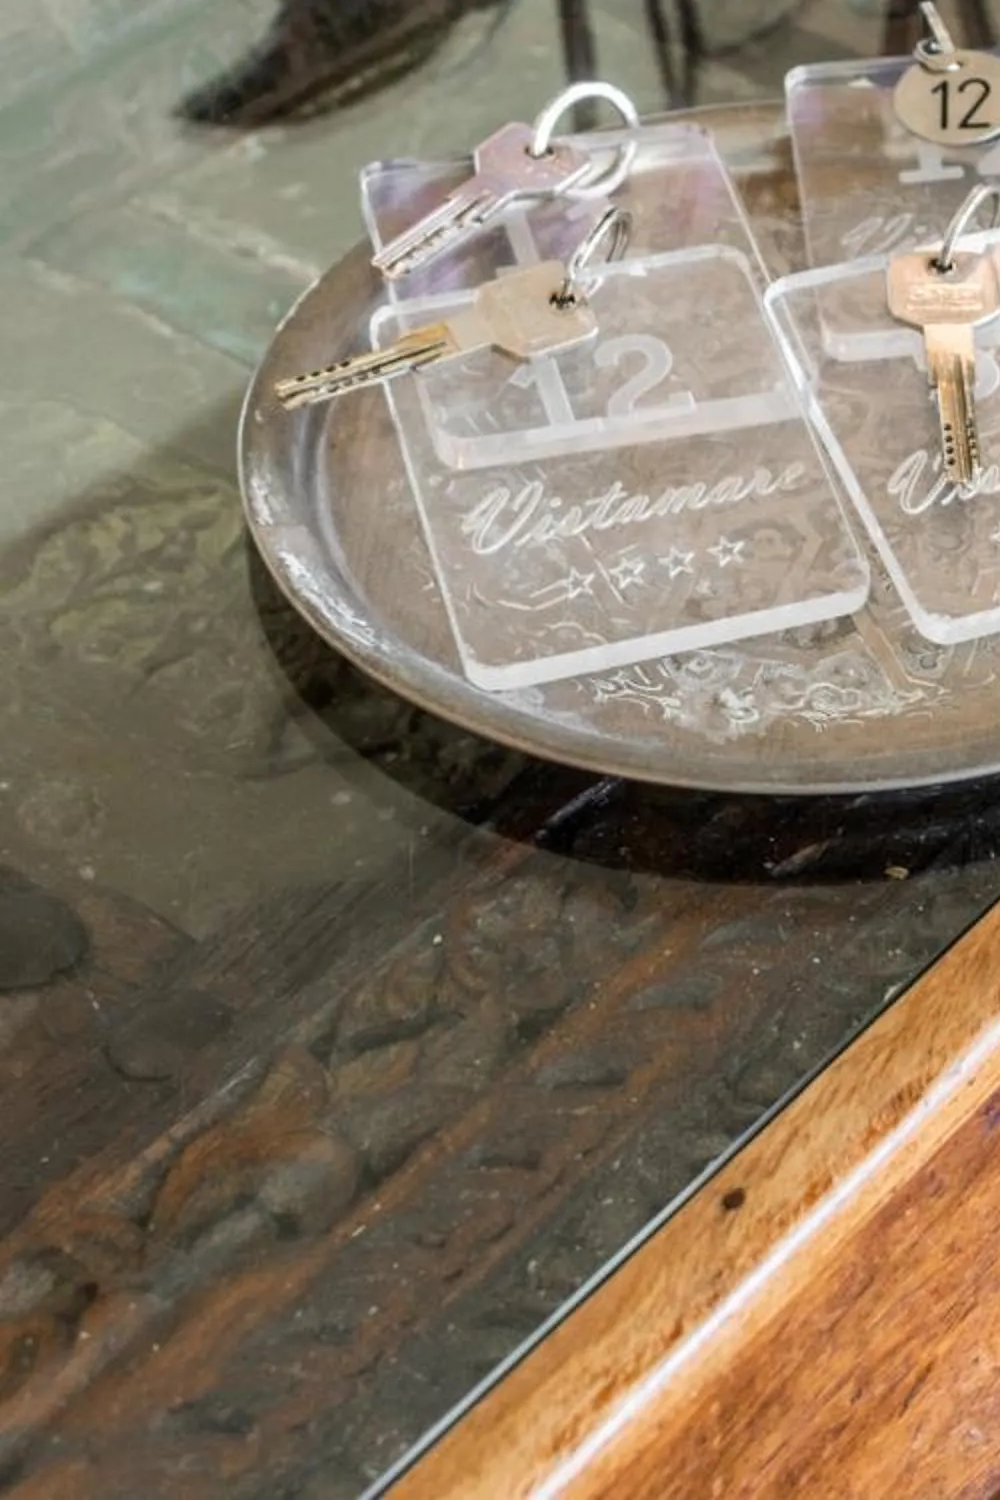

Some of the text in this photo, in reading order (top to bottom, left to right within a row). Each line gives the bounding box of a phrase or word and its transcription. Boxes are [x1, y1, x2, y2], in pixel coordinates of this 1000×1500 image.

[931, 77, 991, 130] 12
[508, 334, 697, 430] 12
[463, 462, 806, 556] Vistamare
